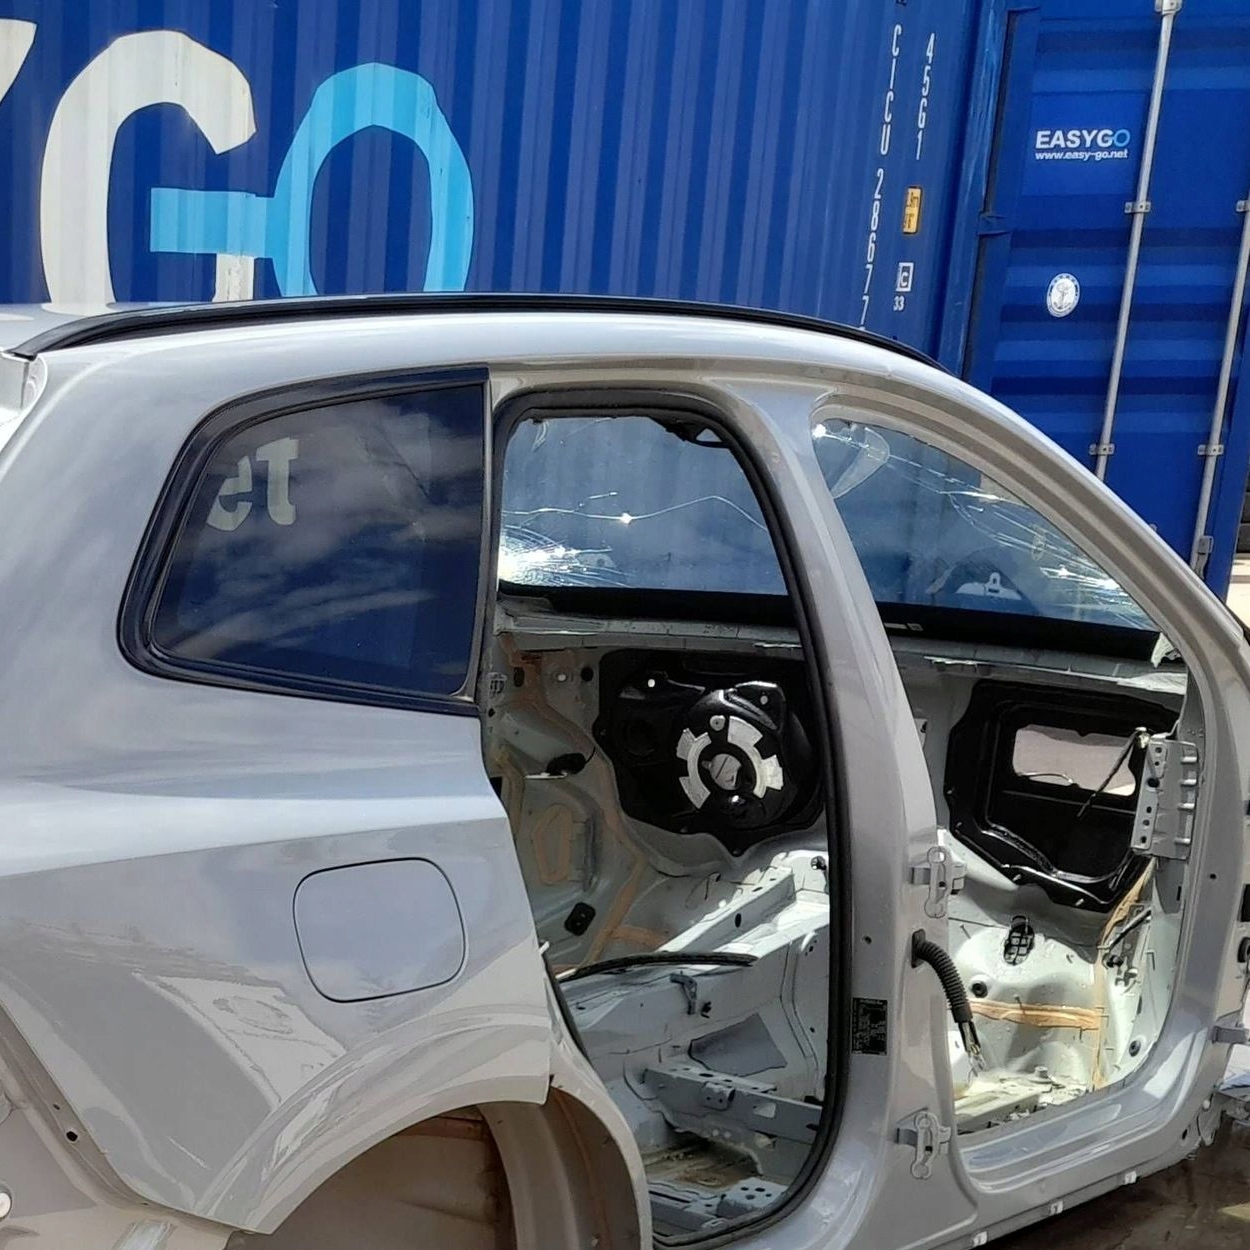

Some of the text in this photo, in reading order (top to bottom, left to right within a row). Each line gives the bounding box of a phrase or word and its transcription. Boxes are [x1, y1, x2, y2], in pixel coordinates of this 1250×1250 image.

[915, 32, 936, 161] 45G1
[1035, 129, 1131, 149] EASYGO
[1035, 149, 1128, 161] www.easy-go.net
[859, 23, 902, 331] CICU 28677
